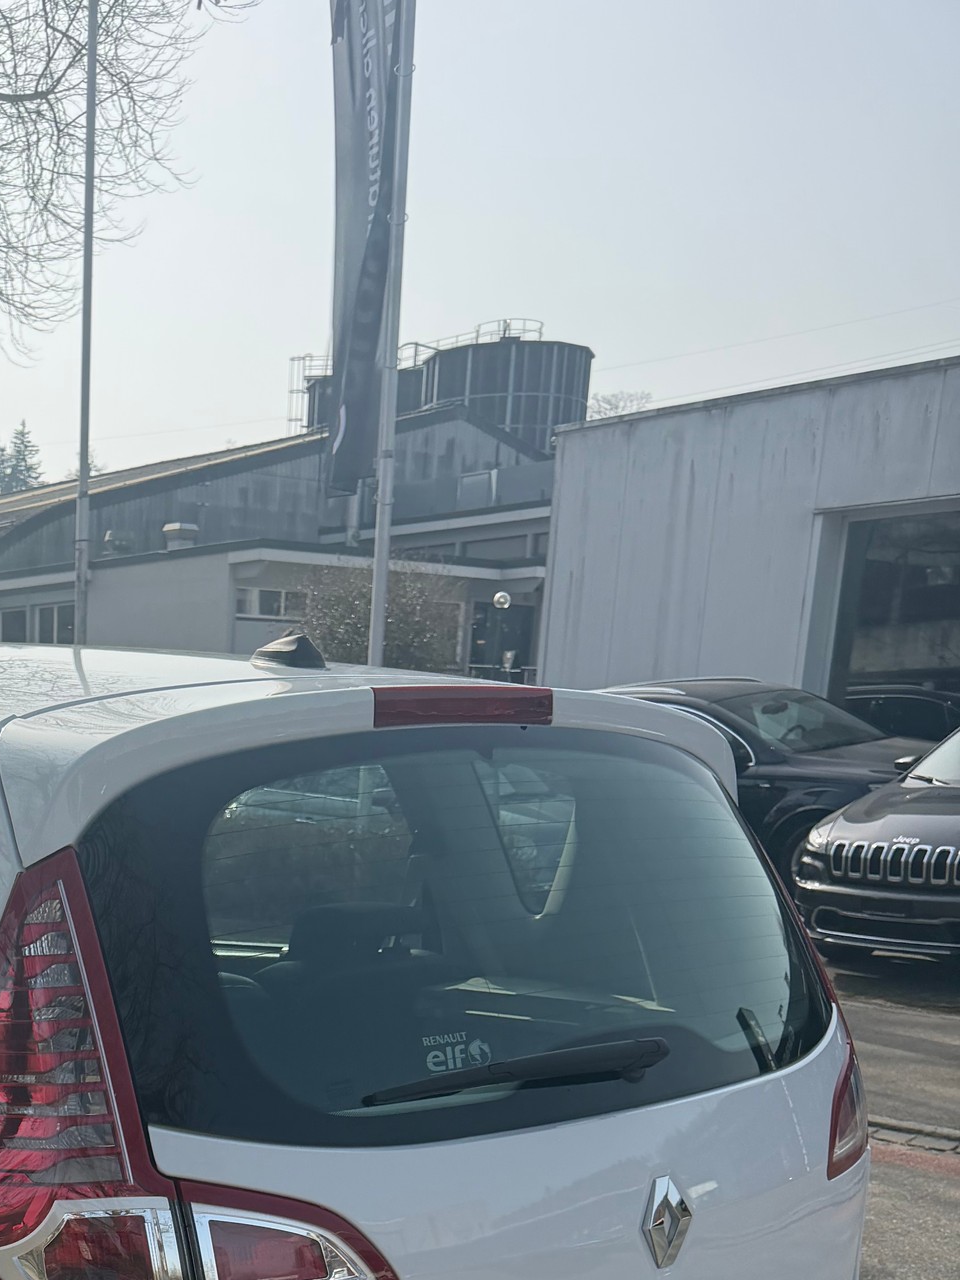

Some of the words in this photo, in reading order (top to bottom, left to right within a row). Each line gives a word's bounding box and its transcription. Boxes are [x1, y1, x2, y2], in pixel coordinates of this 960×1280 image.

[892, 835, 920, 845] Jeep
[422, 1031, 467, 1046] RENAULT
[426, 1044, 466, 1071] elf
